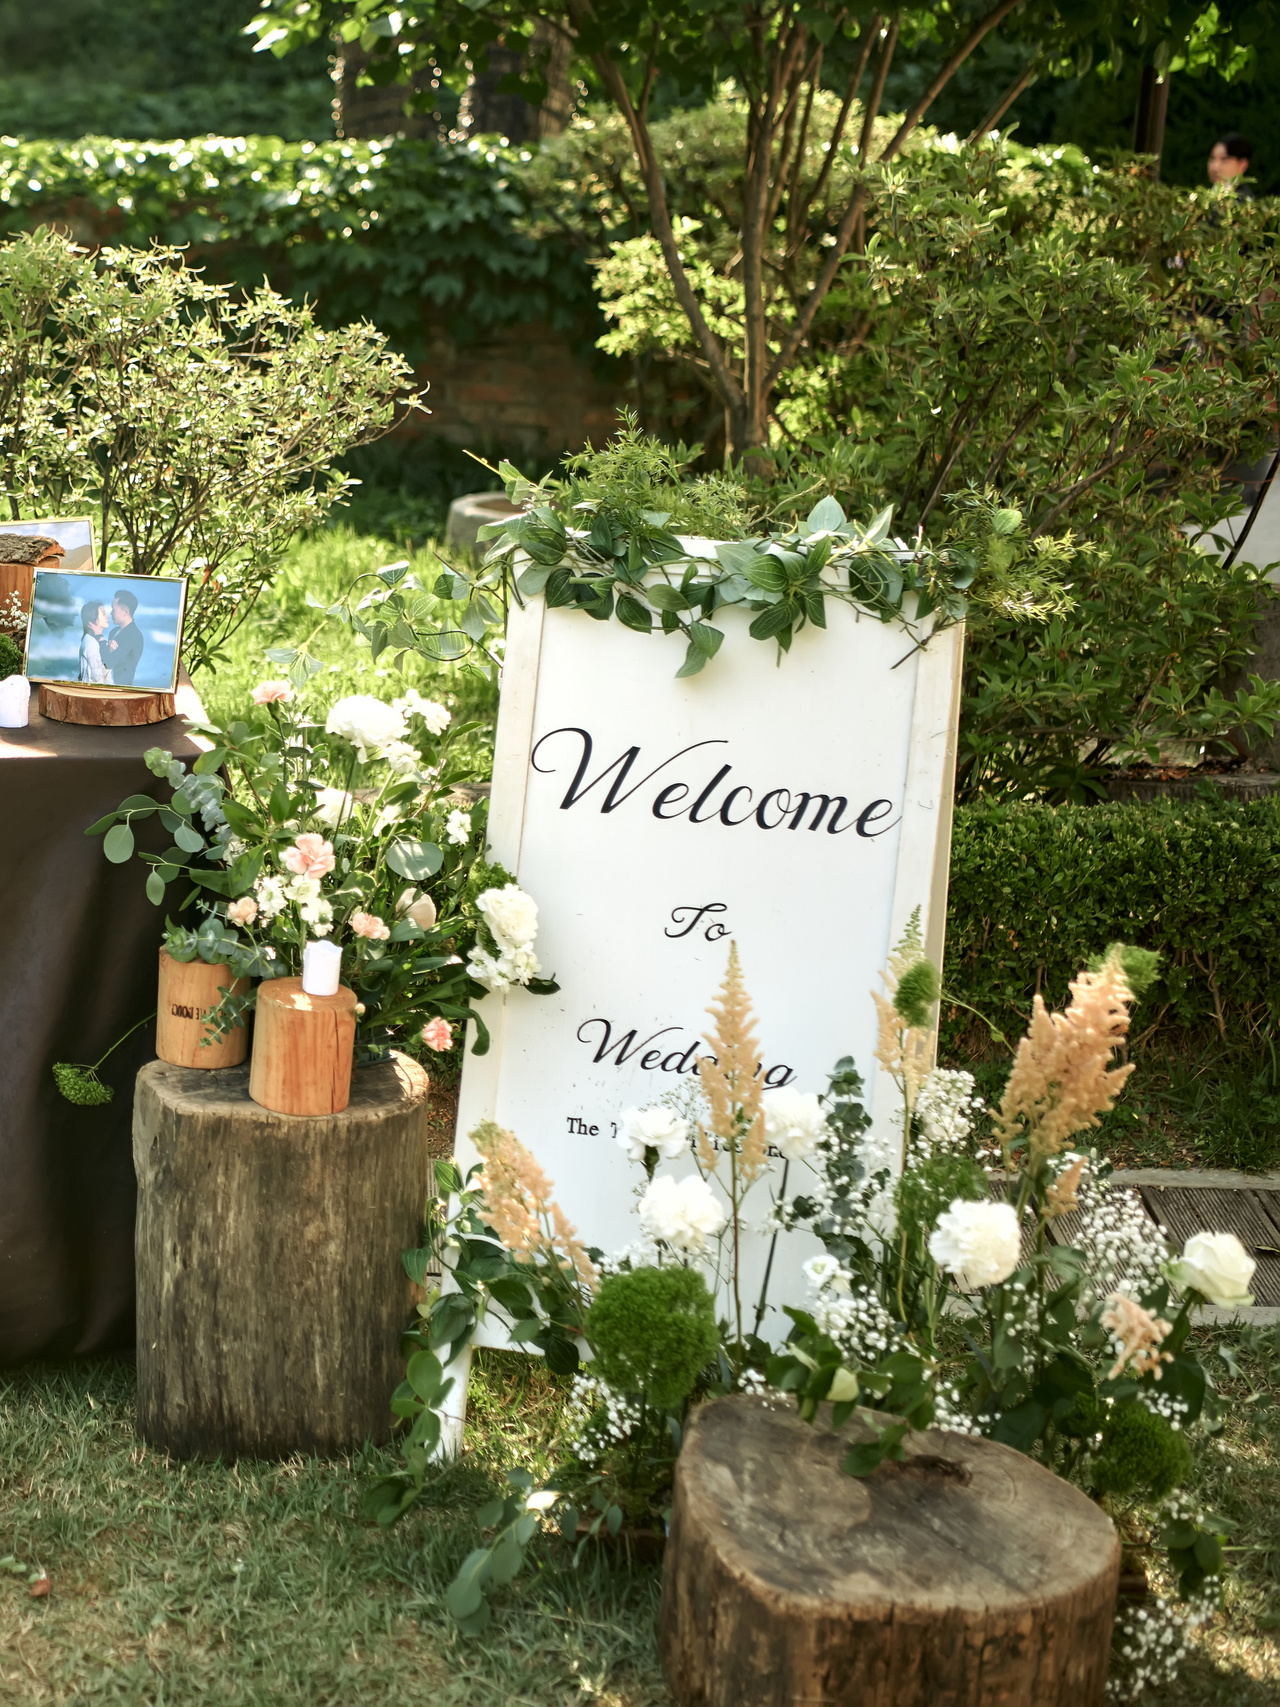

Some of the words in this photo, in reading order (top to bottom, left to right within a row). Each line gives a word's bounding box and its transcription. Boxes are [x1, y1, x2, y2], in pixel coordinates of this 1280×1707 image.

[531, 727, 902, 838] Welcome
[664, 902, 732, 942] To
[566, 1116, 600, 1137] The
